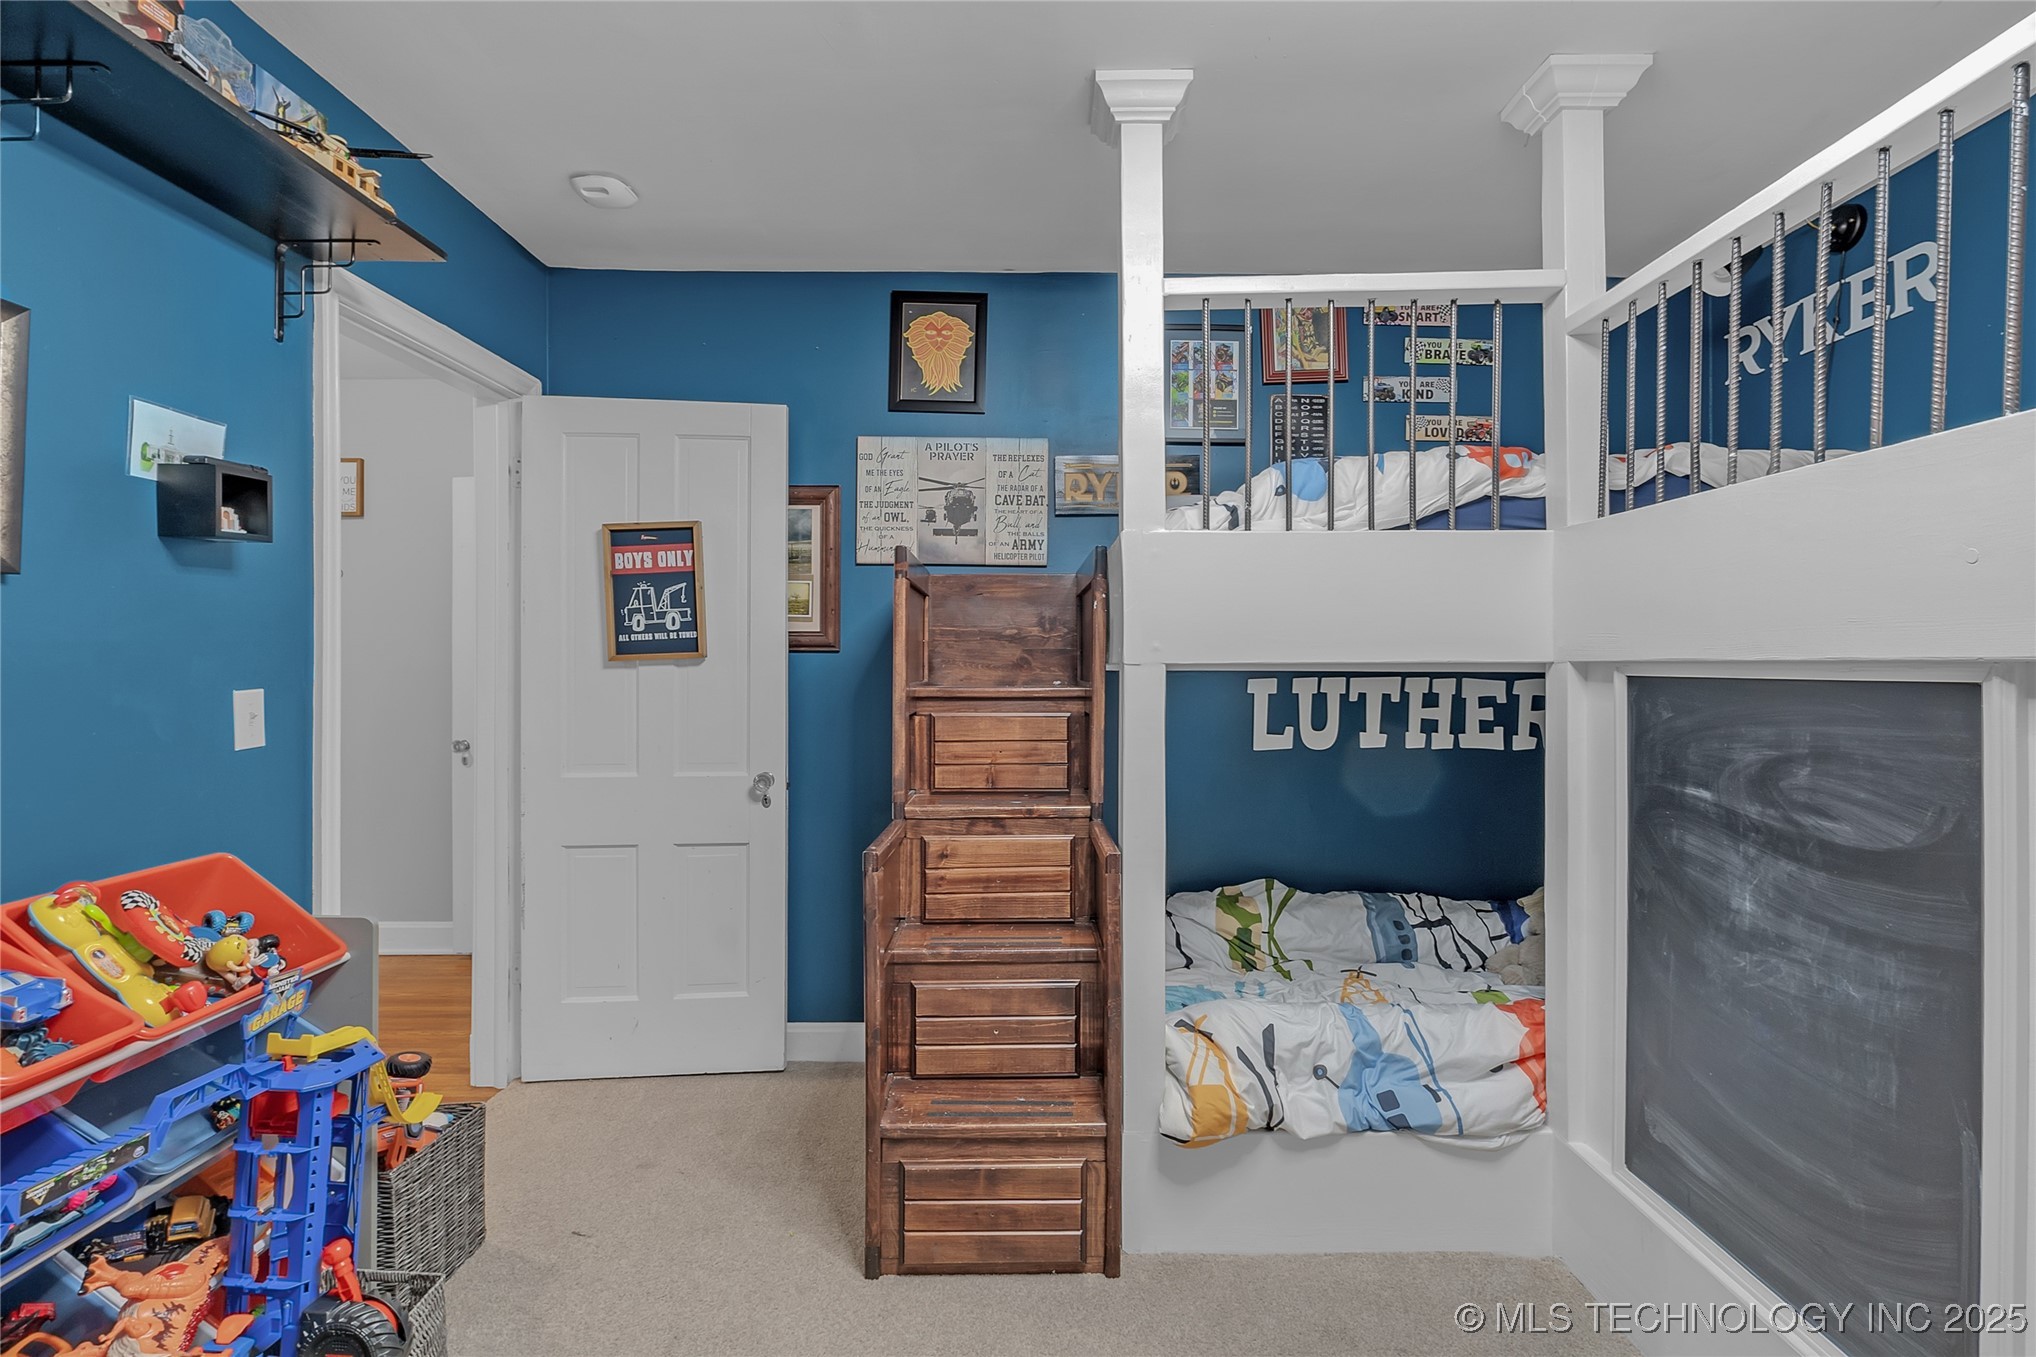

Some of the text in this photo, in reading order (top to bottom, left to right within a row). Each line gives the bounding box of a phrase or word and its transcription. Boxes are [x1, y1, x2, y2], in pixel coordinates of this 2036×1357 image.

[1724, 241, 1939, 386] RYKER
[1402, 389, 1434, 399] KND
[1425, 427, 1464, 438] LOVD
[925, 442, 979, 452] A PILOT'S
[859, 446, 910, 464] GOD Grant
[930, 452, 974, 461] PRAYER
[992, 454, 1044, 462] THE REFLEXES
[998, 464, 1044, 482] OF A Cat
[865, 479, 910, 500] OF AN Eagle
[997, 484, 1043, 492] THE RADAR OF A
[859, 501, 914, 509] THE JUDGMENT
[994, 495, 1023, 506] CAVE
[862, 512, 870, 524] of
[884, 512, 910, 523] OWL.
[1025, 516, 1043, 529] and
[1012, 539, 1044, 550] ARMY
[614, 550, 694, 570] BOYS ONLY
[994, 553, 1044, 561] HELICOPTER PILOT
[619, 634, 629, 642] ALL
[631, 633, 653, 641] OTHERS
[654, 632, 668, 640] WILL
[1247, 676, 1545, 751] LUTHER
[250, 989, 306, 1032] GARAGE
